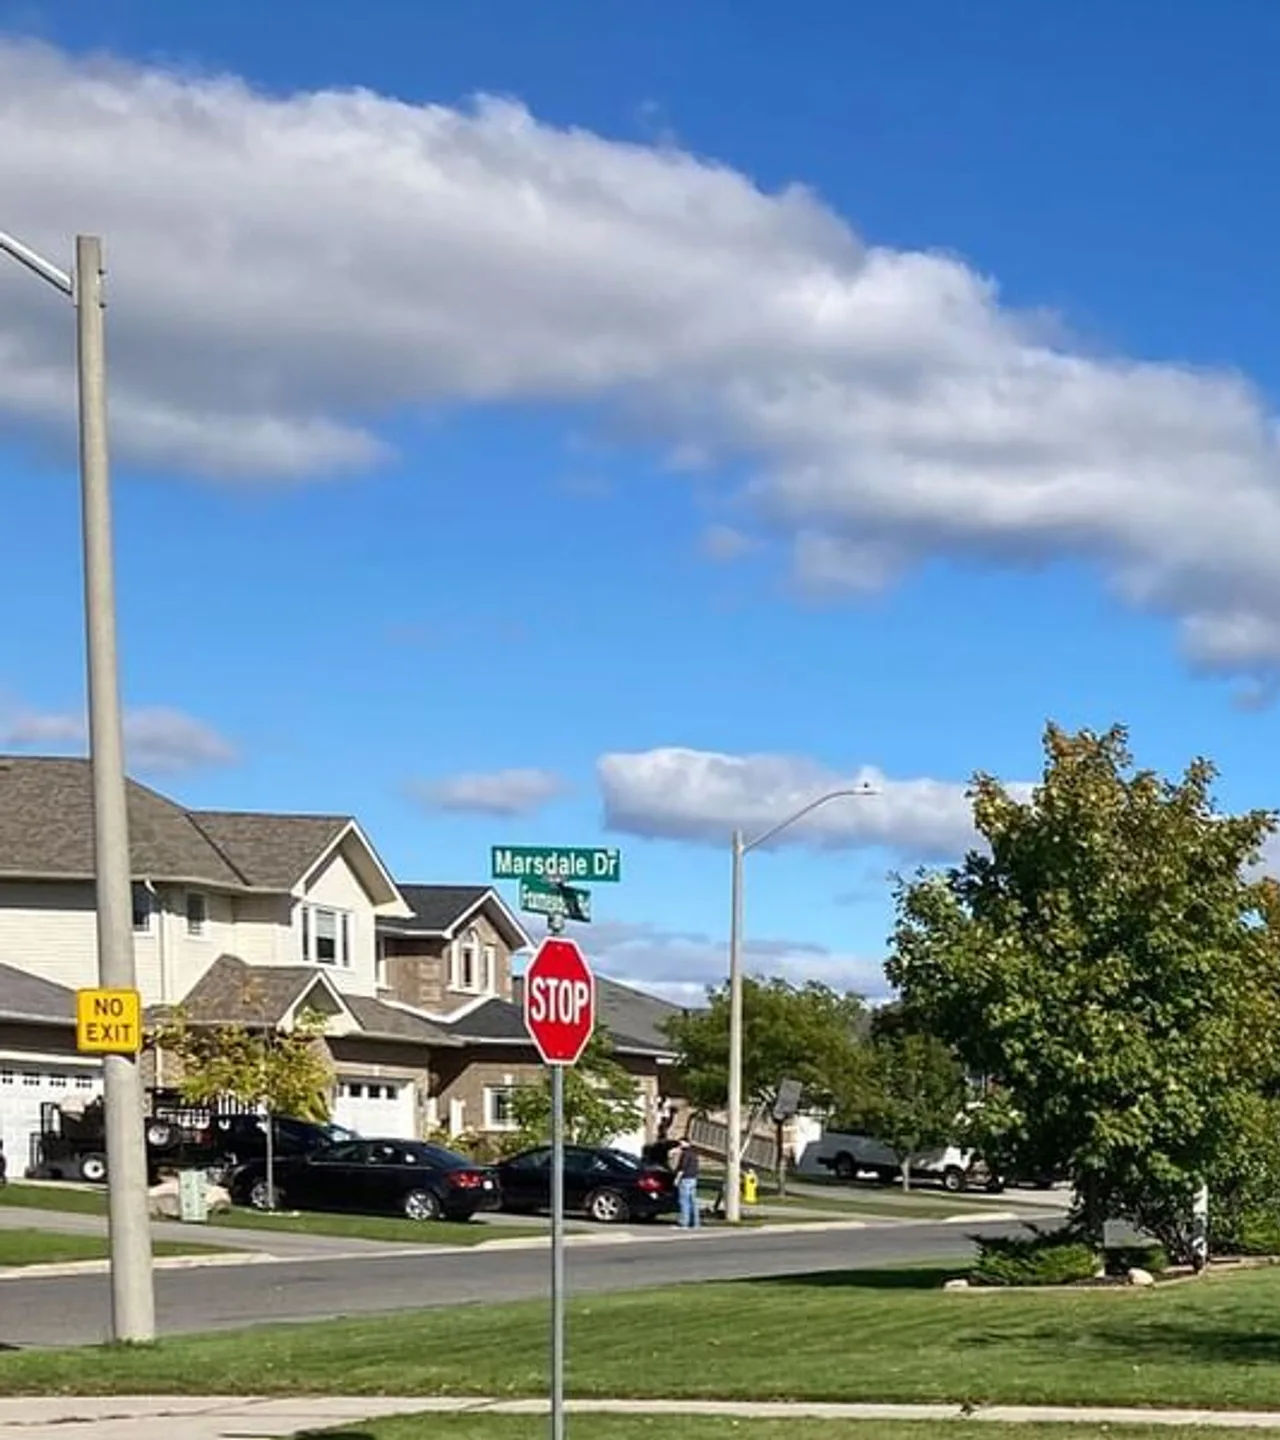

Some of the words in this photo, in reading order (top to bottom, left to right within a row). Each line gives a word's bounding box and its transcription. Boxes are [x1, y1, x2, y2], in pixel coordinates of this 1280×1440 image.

[495, 850, 587, 876] Marsdale
[594, 851, 618, 876] Dr
[94, 998, 124, 1017] NO
[530, 976, 589, 1025] STOP
[86, 1022, 133, 1043] EXIT
